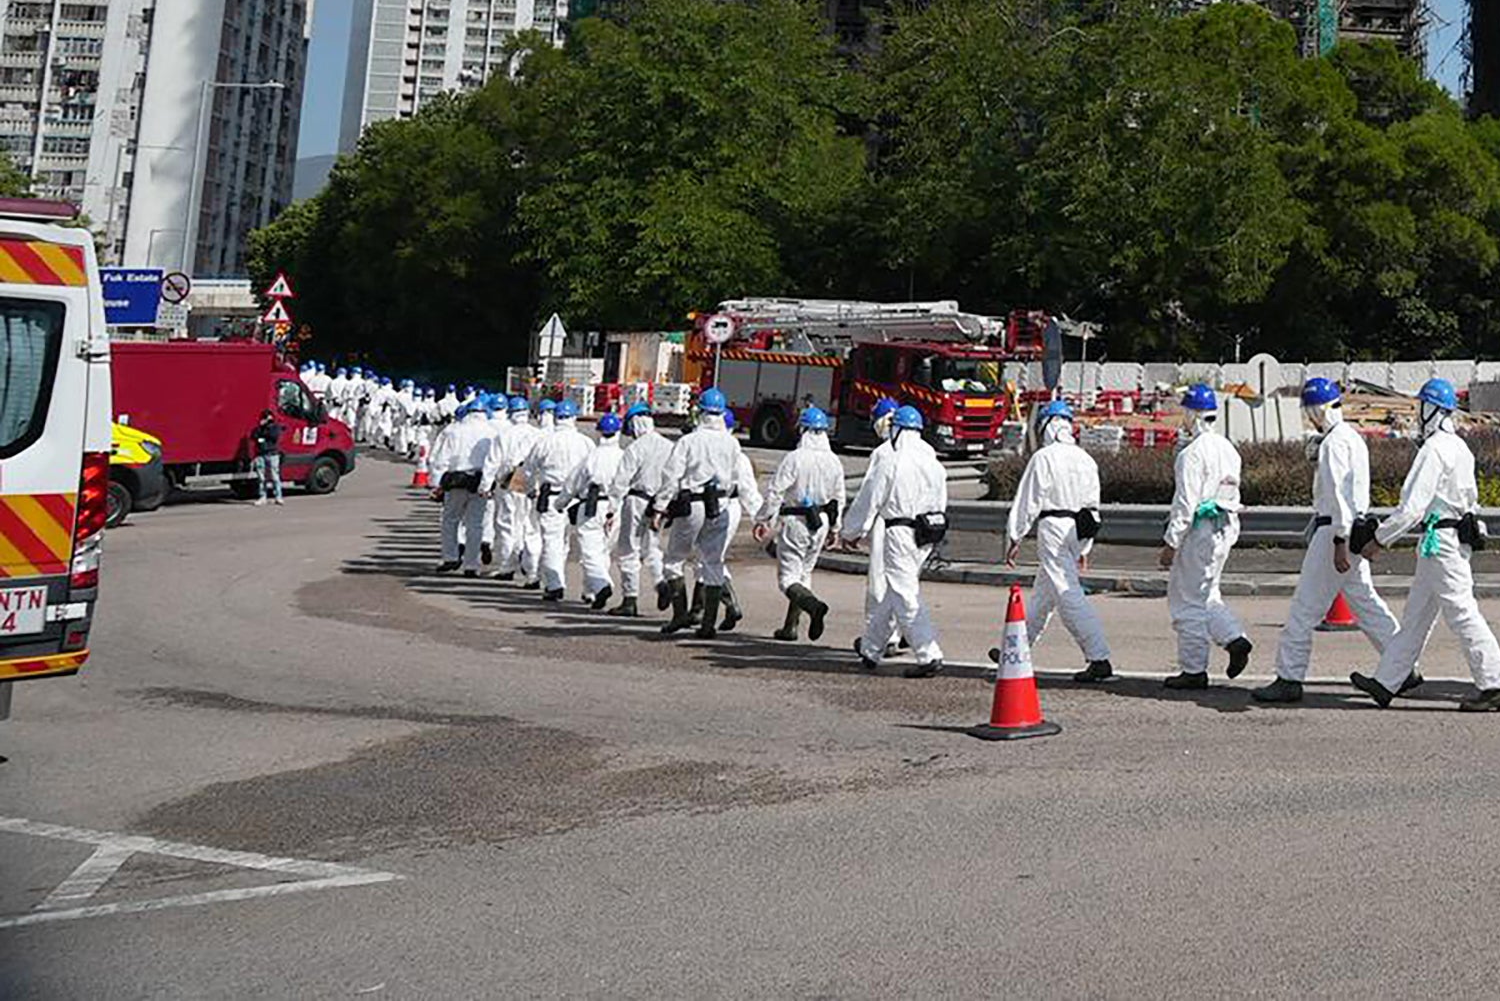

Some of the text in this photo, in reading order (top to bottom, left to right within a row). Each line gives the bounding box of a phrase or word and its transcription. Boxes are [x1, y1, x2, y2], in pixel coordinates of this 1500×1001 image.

[103, 272, 160, 282] Fuk Estate
[104, 300, 130, 308] ouse
[1, 612, 16, 632] 4
[1002, 651, 1027, 665] POL
